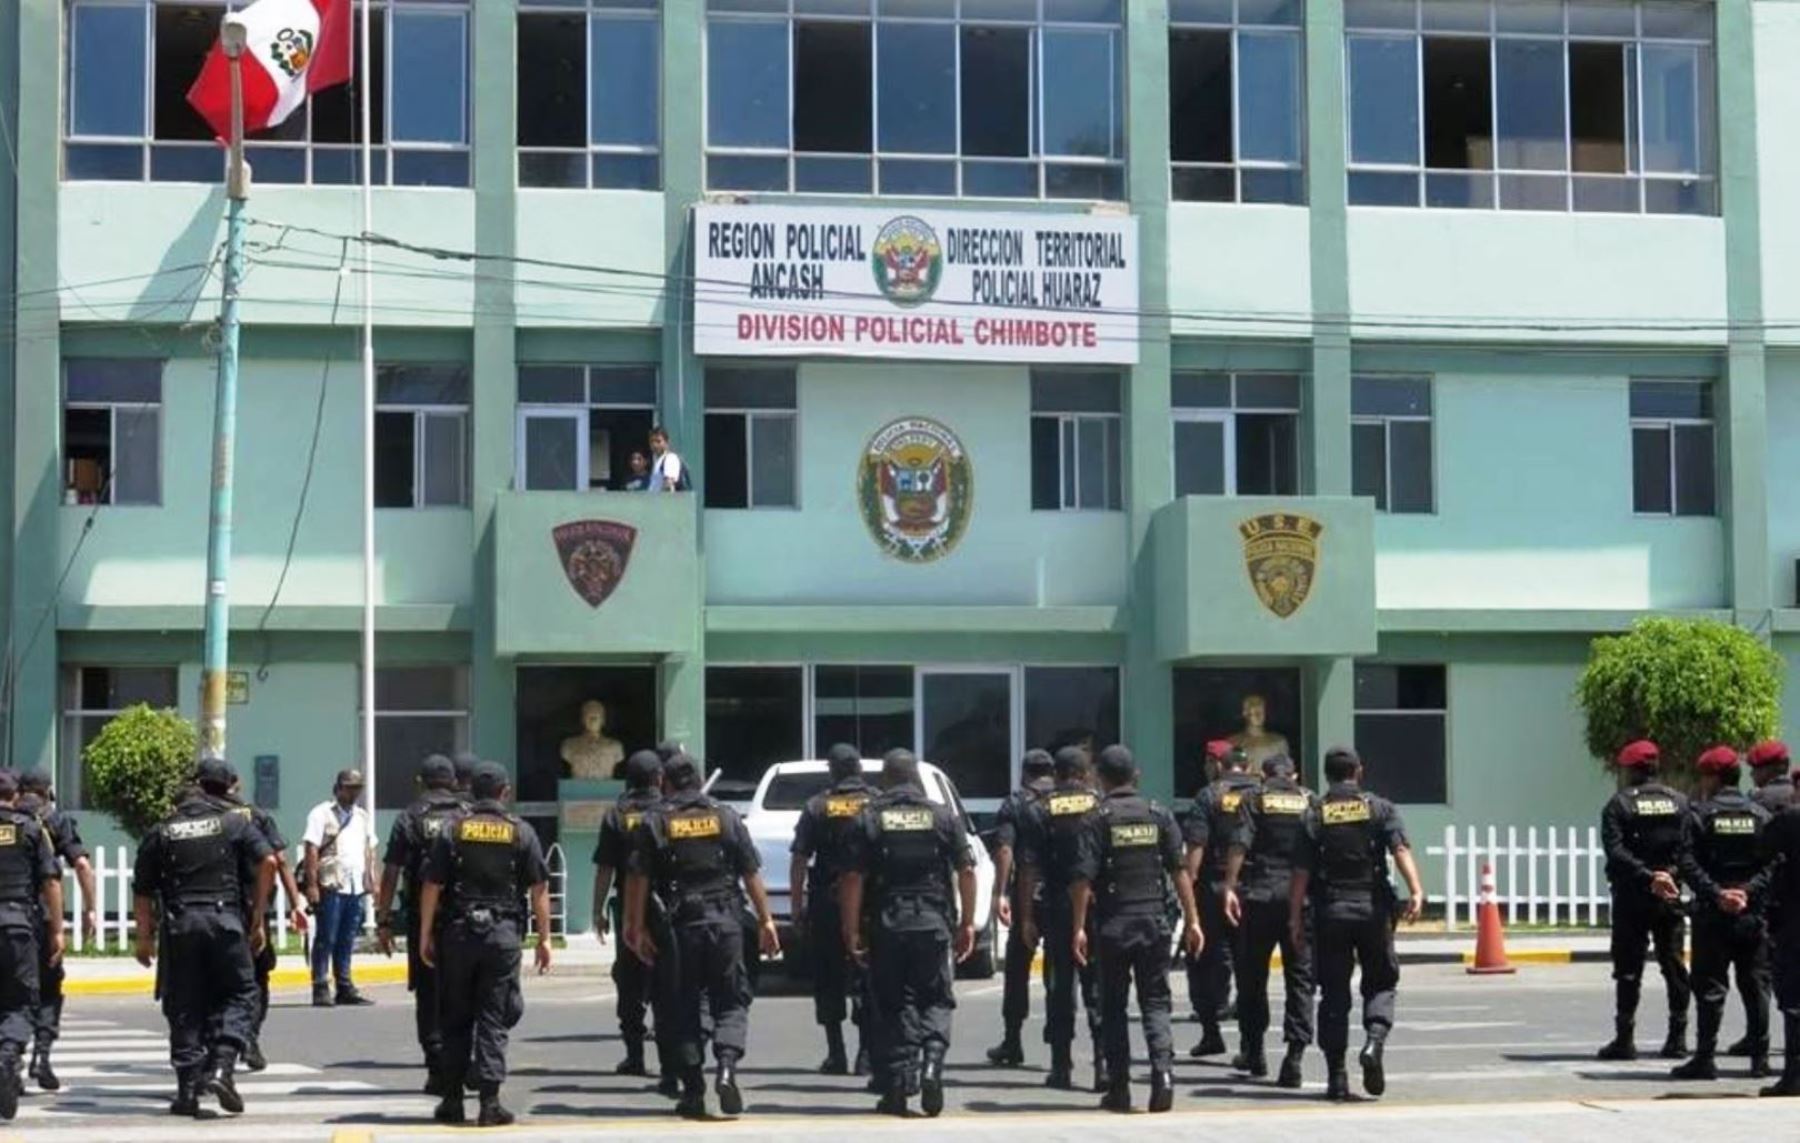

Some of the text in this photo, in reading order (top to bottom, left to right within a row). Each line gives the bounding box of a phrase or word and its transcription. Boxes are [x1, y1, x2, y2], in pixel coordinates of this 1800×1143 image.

[709, 222, 775, 259] REGION
[786, 224, 866, 261] POLICIAL
[947, 228, 1023, 265] DIRECCION
[1036, 231, 1125, 268] TERRITORIAL
[750, 263, 824, 299] ANCASH
[972, 270, 1101, 307] POLICIAL HUARAZ
[738, 314, 1096, 347] DIVISION POLICIAL CHIMBOTE
[464, 822, 511, 839] POLICIA
[672, 816, 719, 835] POLICIA
[884, 811, 930, 828] POLICIA
[1715, 818, 1753, 829] POLICIA
